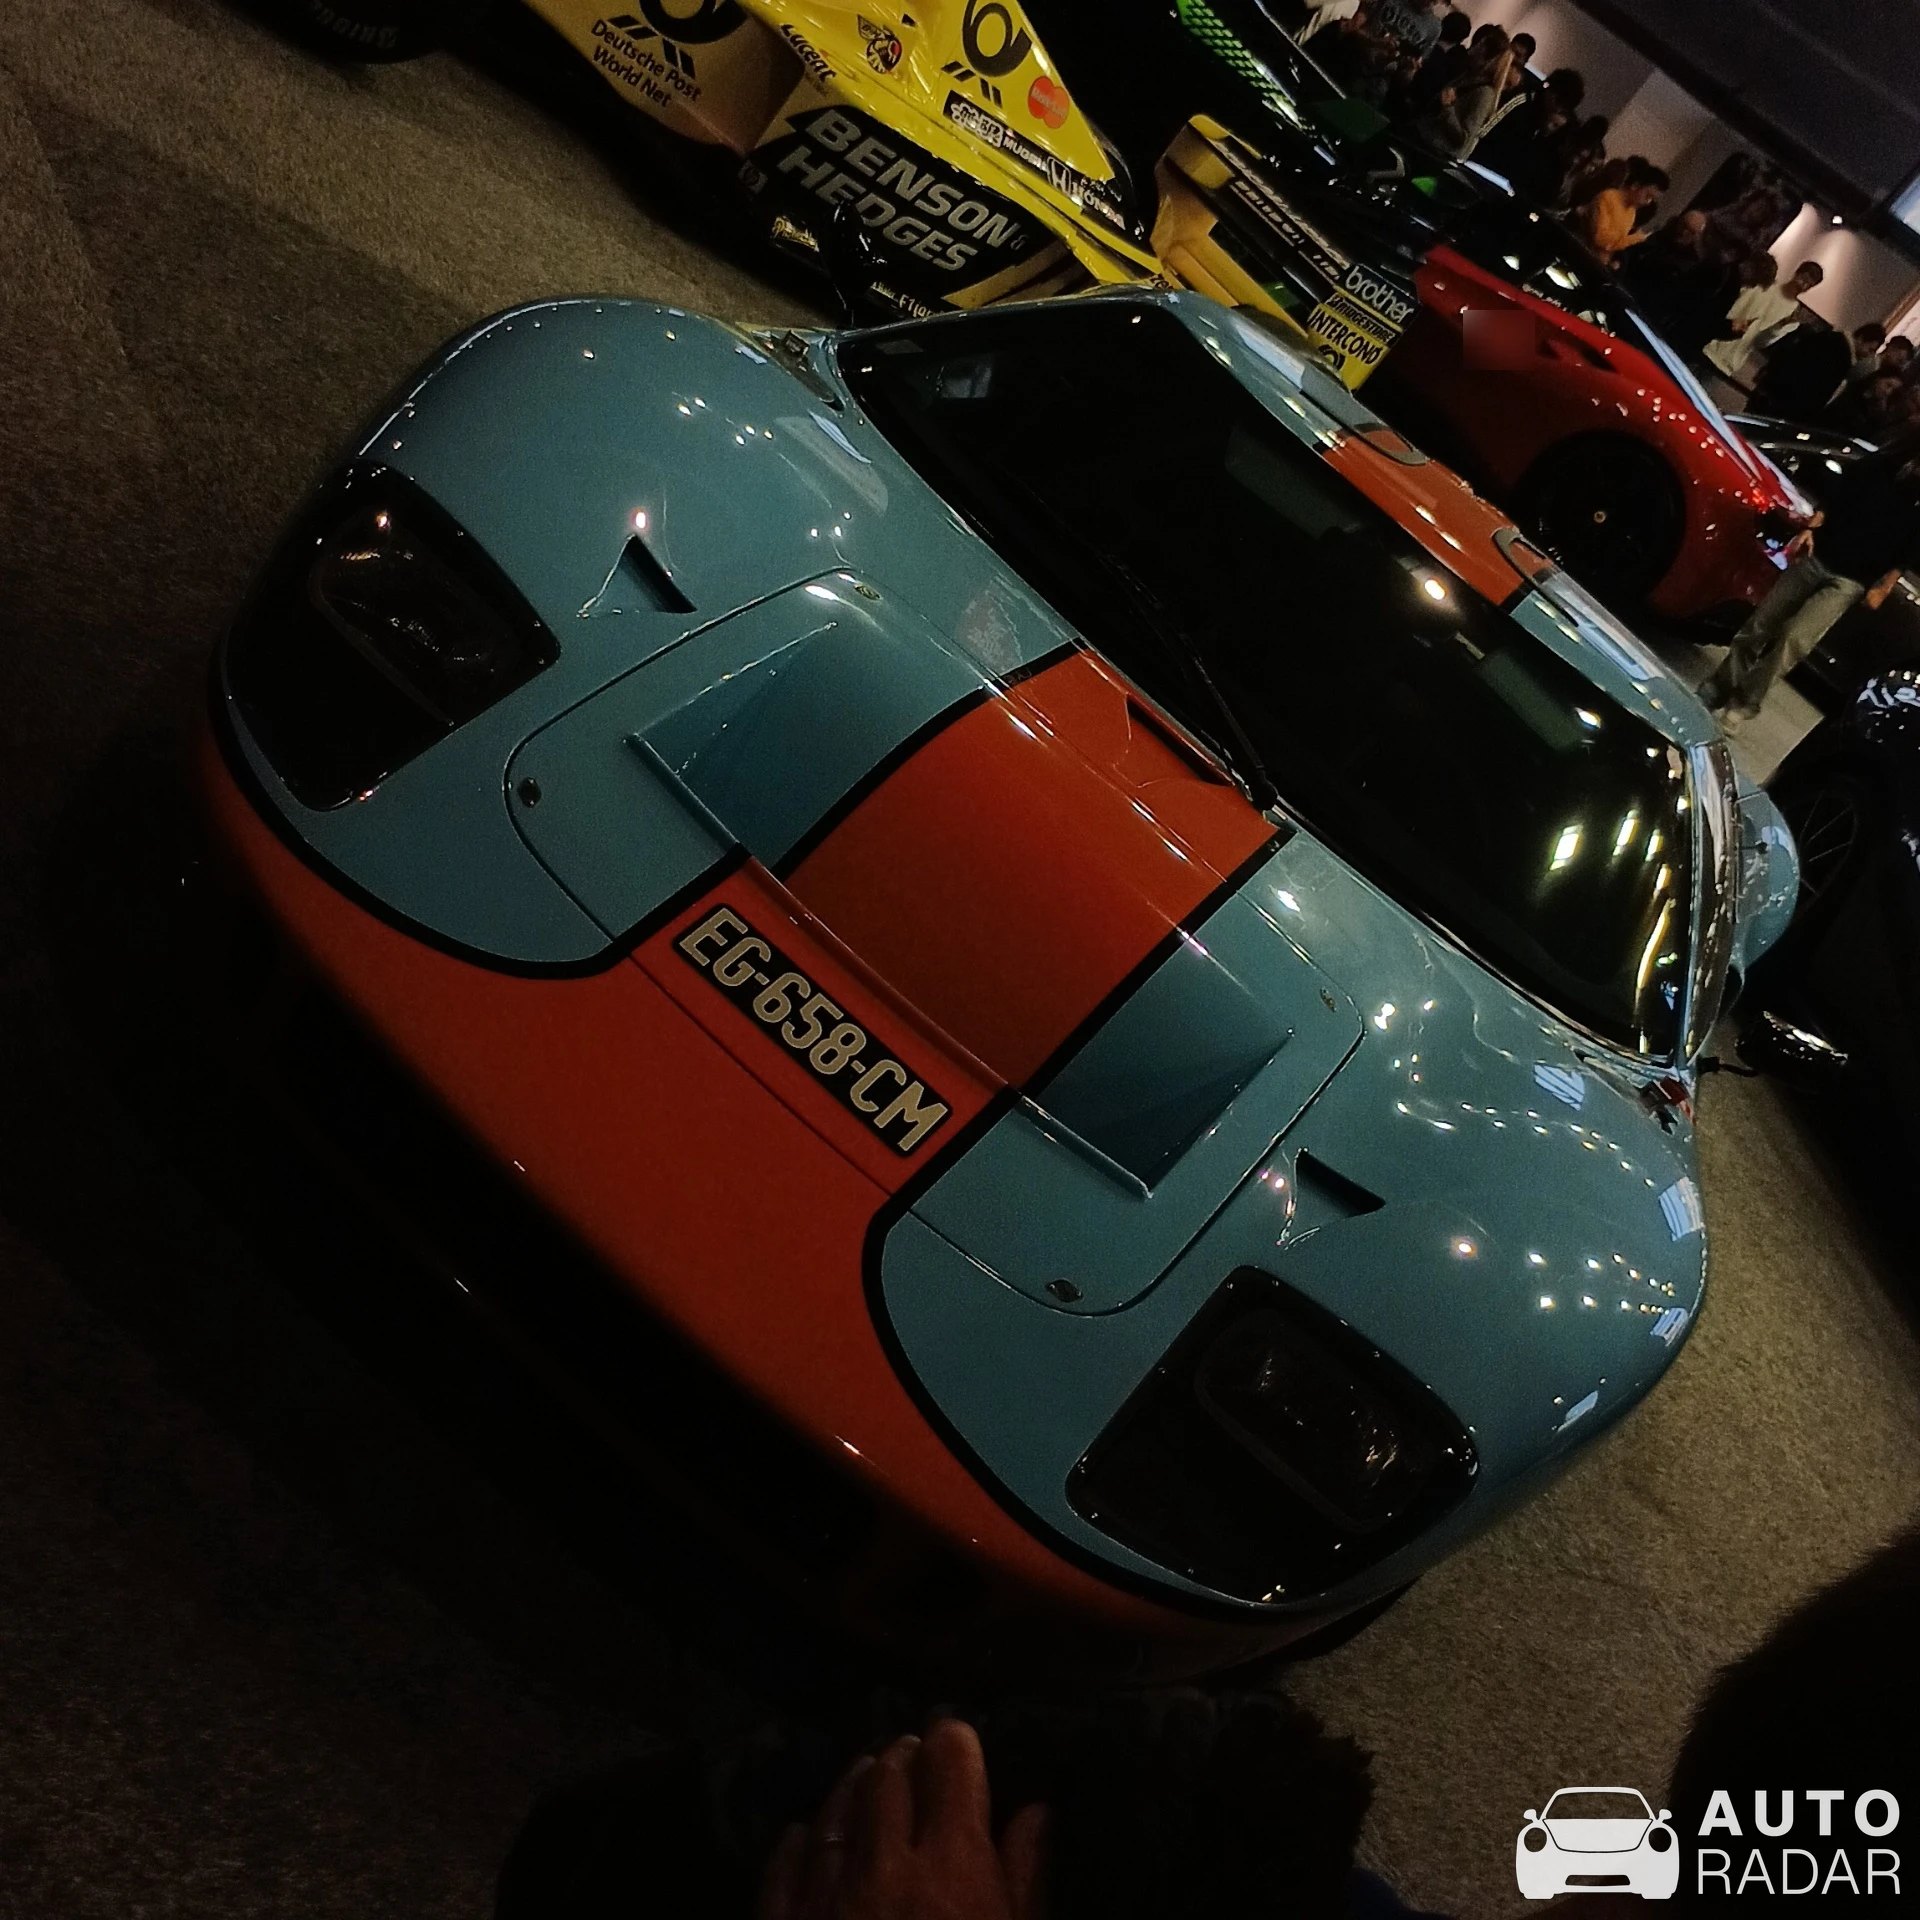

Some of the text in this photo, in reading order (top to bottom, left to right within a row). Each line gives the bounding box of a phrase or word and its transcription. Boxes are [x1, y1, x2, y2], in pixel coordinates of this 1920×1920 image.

[591, 19, 701, 102] Deutsche Post
[593, 45, 672, 108] World Net
[780, 24, 837, 82] Lucent
[776, 144, 980, 272] HEDGES
[804, 108, 1022, 249] BENSON
[1344, 264, 1415, 324] brother
[678, 906, 949, 1152] EG-658-CM
